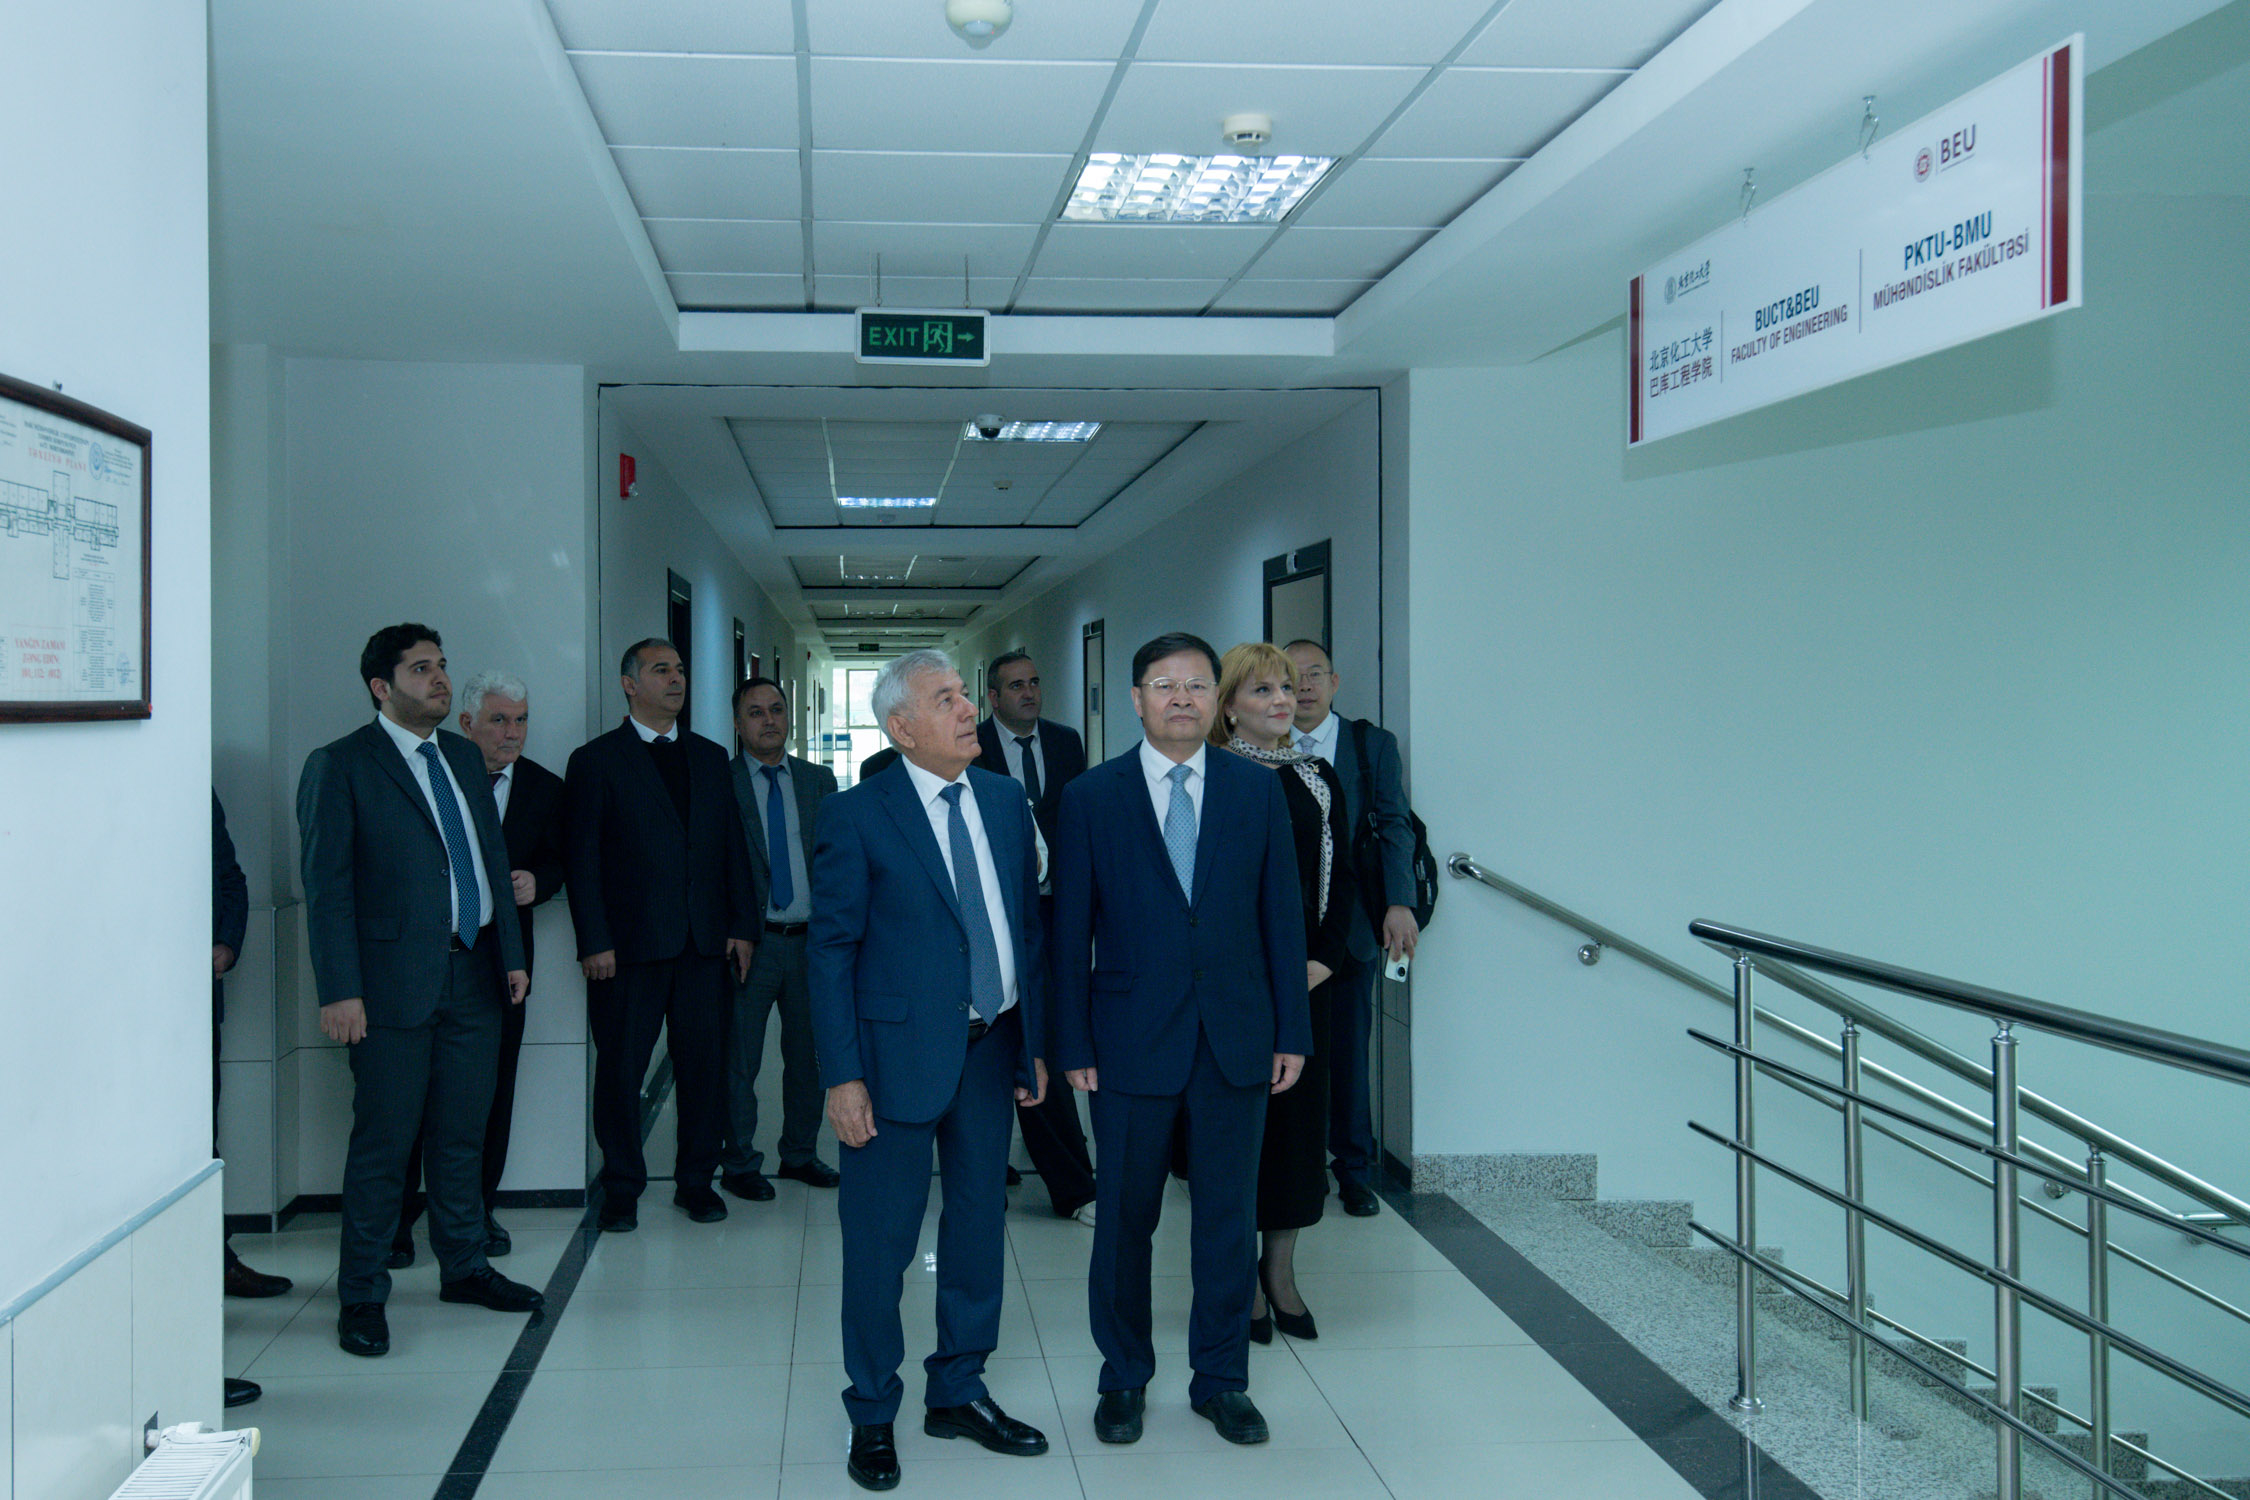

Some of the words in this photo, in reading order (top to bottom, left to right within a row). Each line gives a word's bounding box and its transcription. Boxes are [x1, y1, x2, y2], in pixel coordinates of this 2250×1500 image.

[1940, 123, 1977, 165] BEU
[1903, 210, 1993, 271] PKTU-BMU
[1755, 285, 1820, 332] BUCT&BEU
[869, 326, 920, 347] EXIT
[1649, 326, 1713, 372] 北京化工大学
[1730, 334, 1768, 364] FACULTY
[1769, 330, 1782, 350] OF
[1783, 304, 1848, 345] ENGINEERING
[1650, 356, 1713, 398] 巴库工程学院
